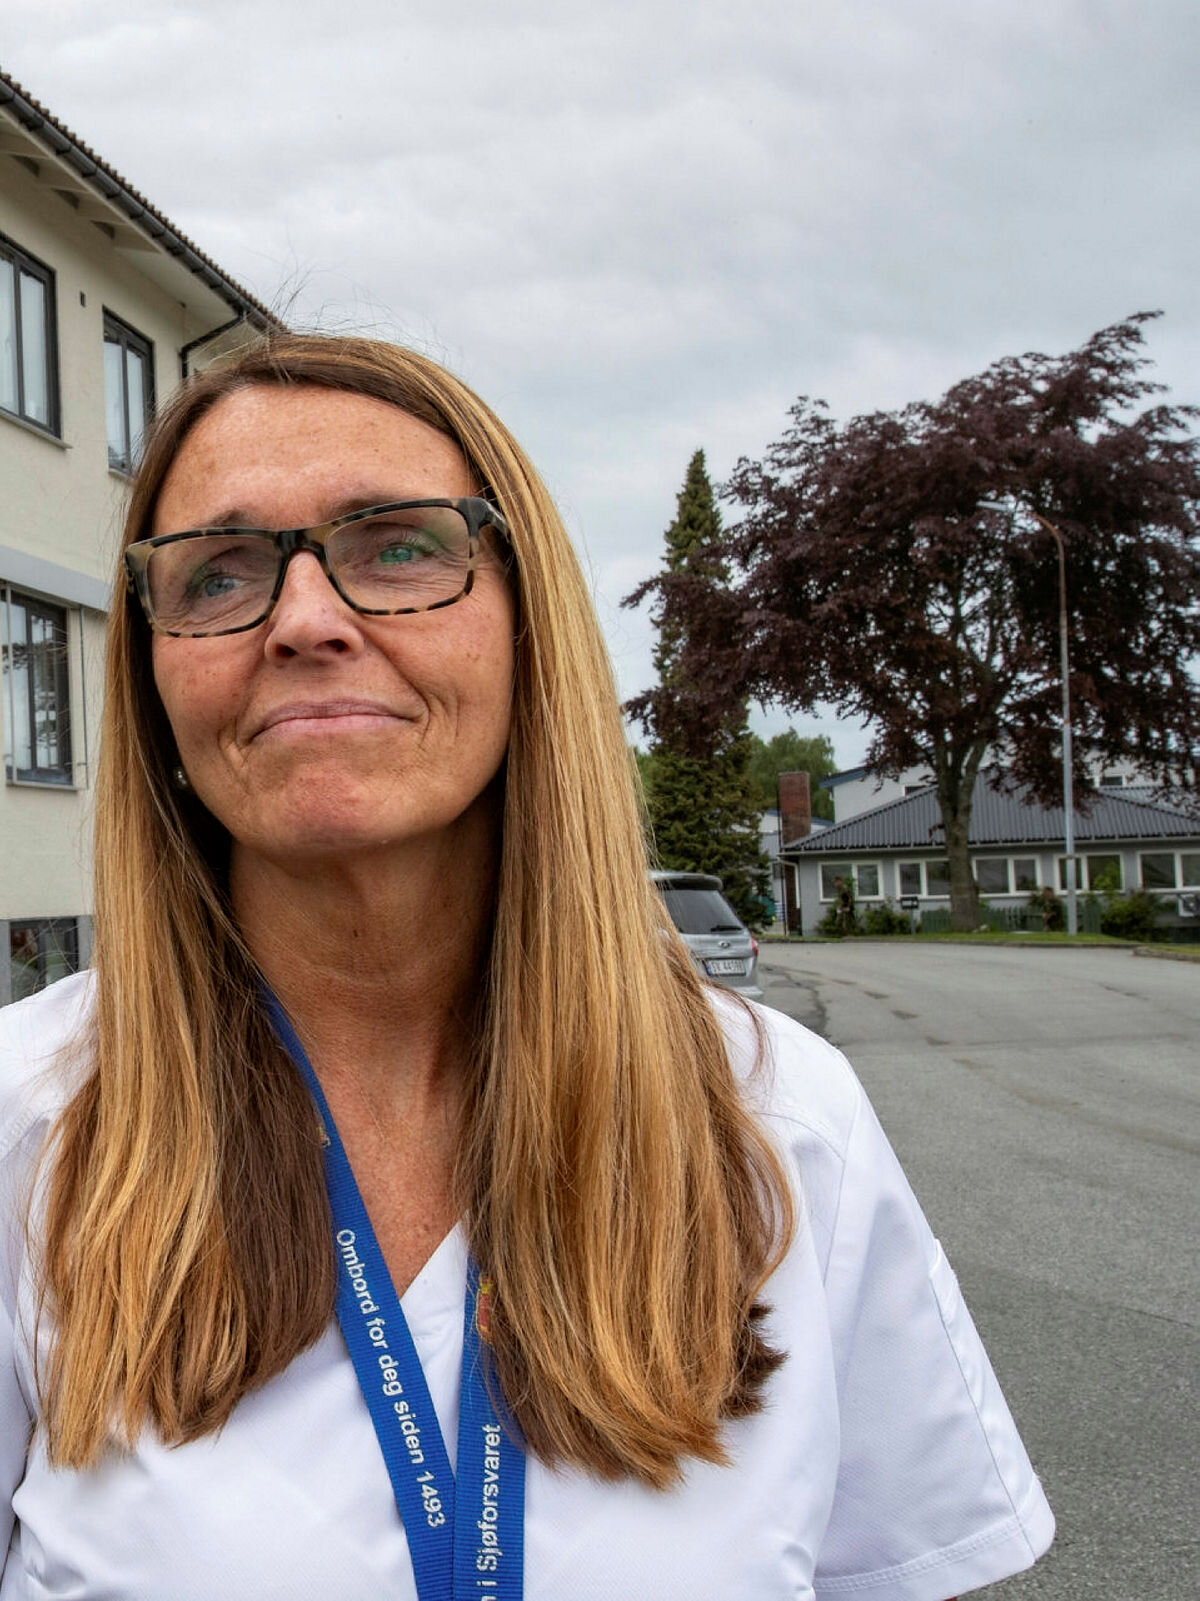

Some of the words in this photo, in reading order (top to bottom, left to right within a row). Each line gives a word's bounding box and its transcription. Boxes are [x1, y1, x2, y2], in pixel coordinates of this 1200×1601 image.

[336, 1228, 380, 1315] Ombord
[365, 1317, 389, 1349] for
[378, 1354, 404, 1396] deg
[393, 1400, 425, 1465] siden
[416, 1470, 447, 1528] 1493
[476, 1424, 503, 1572] Sjøforsvaret
